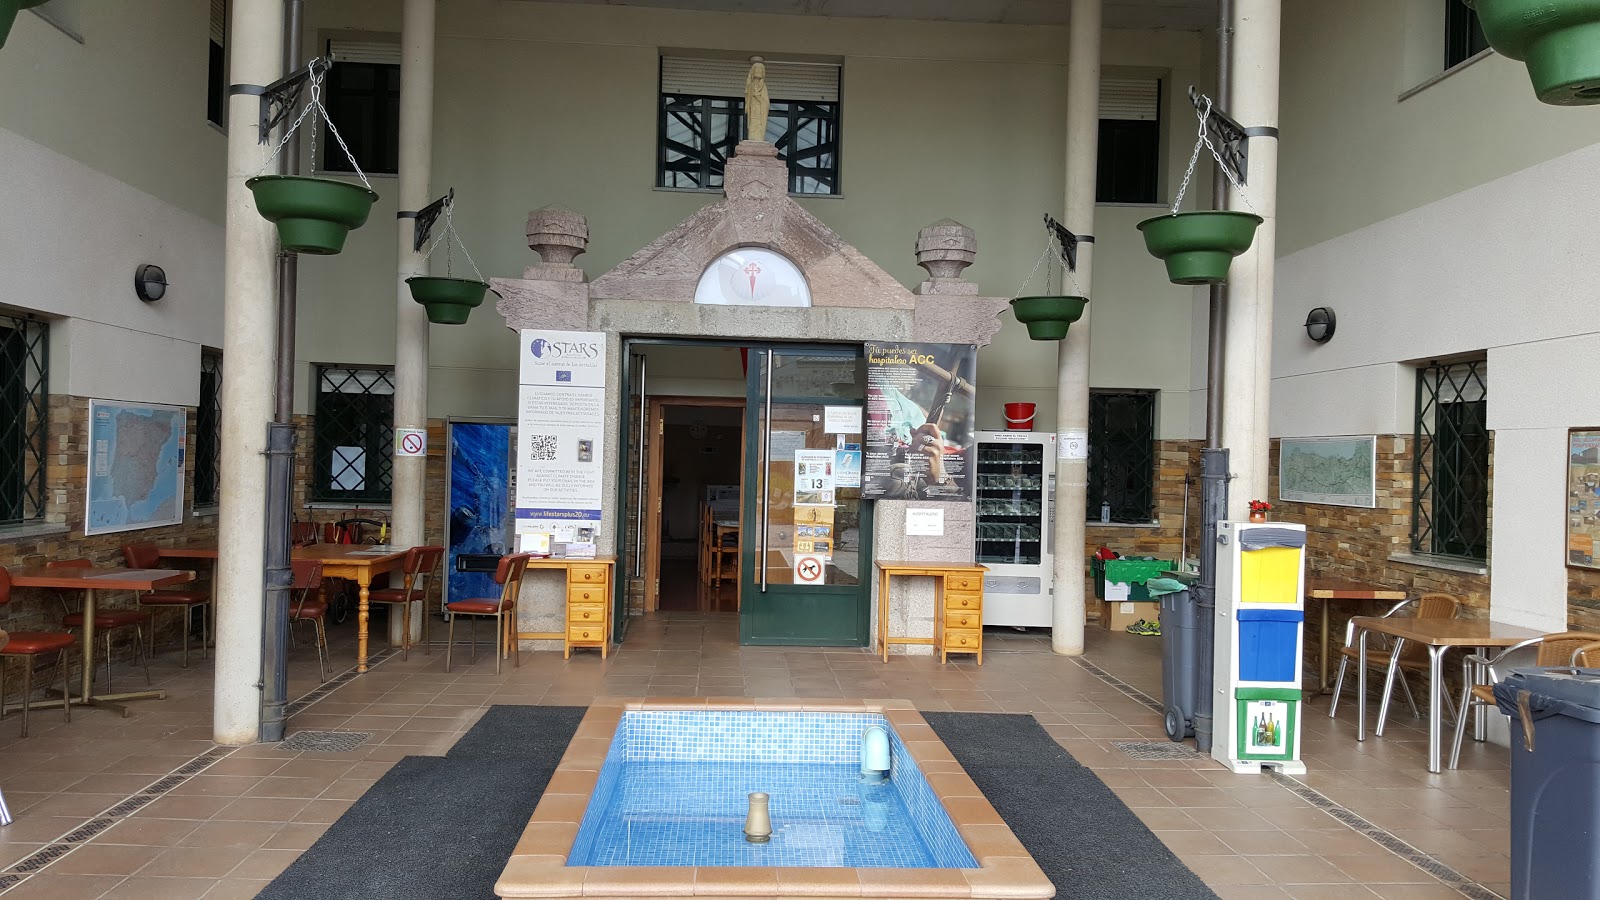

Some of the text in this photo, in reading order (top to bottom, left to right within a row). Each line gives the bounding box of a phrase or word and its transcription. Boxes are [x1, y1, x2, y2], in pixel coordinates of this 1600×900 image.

[552, 342, 598, 359] STARS
[881, 345, 906, 356] puedes
[869, 354, 934, 366] hospitalero ACC
[811, 479, 823, 489] 13
